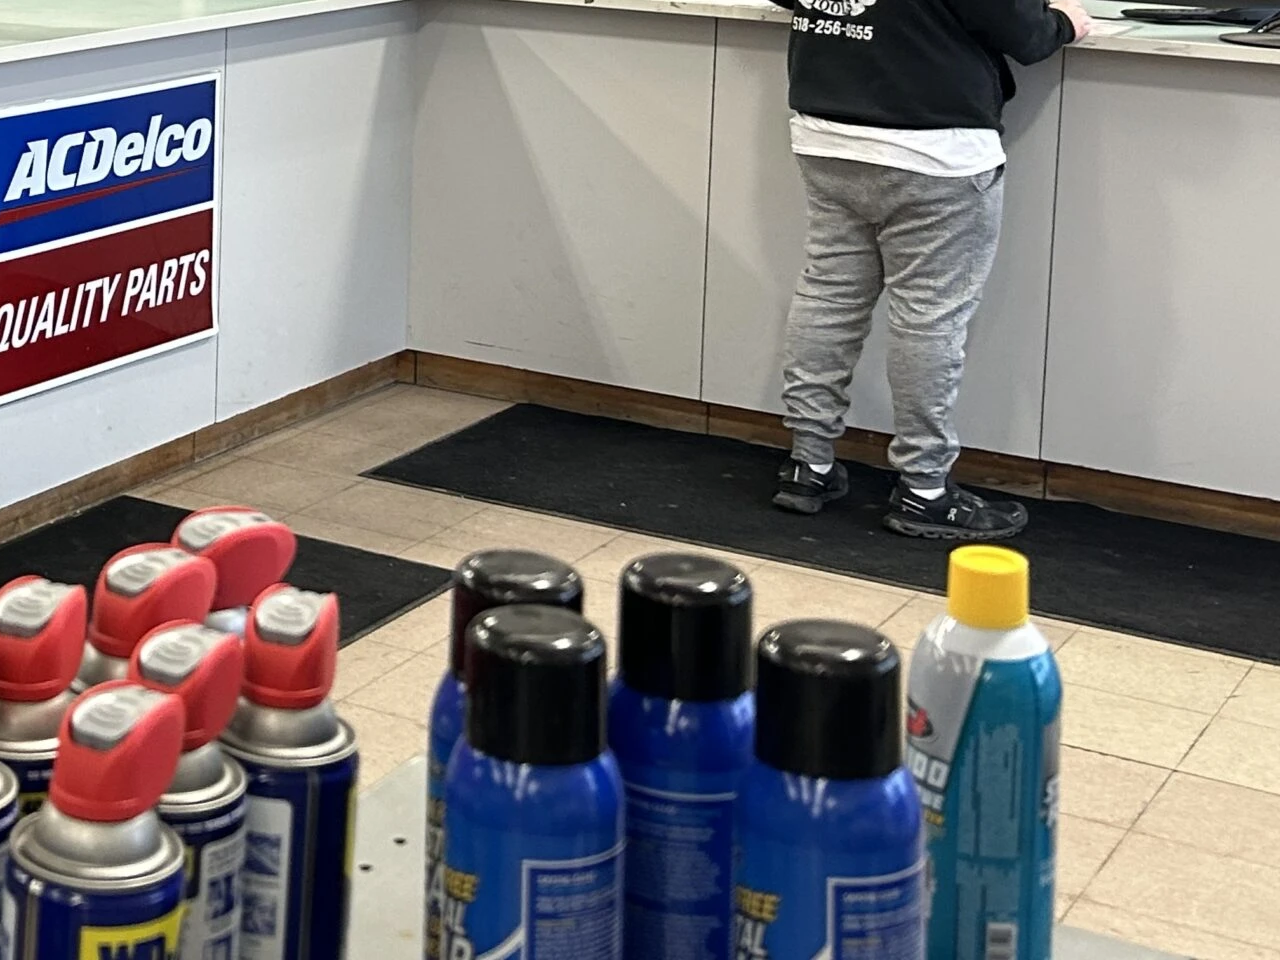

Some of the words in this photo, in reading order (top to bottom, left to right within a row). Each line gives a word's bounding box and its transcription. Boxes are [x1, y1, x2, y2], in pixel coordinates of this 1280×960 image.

[792, 16, 874, 41] 518-256-0555
[3, 114, 213, 202] ACDelco
[120, 248, 210, 317] PARTS
